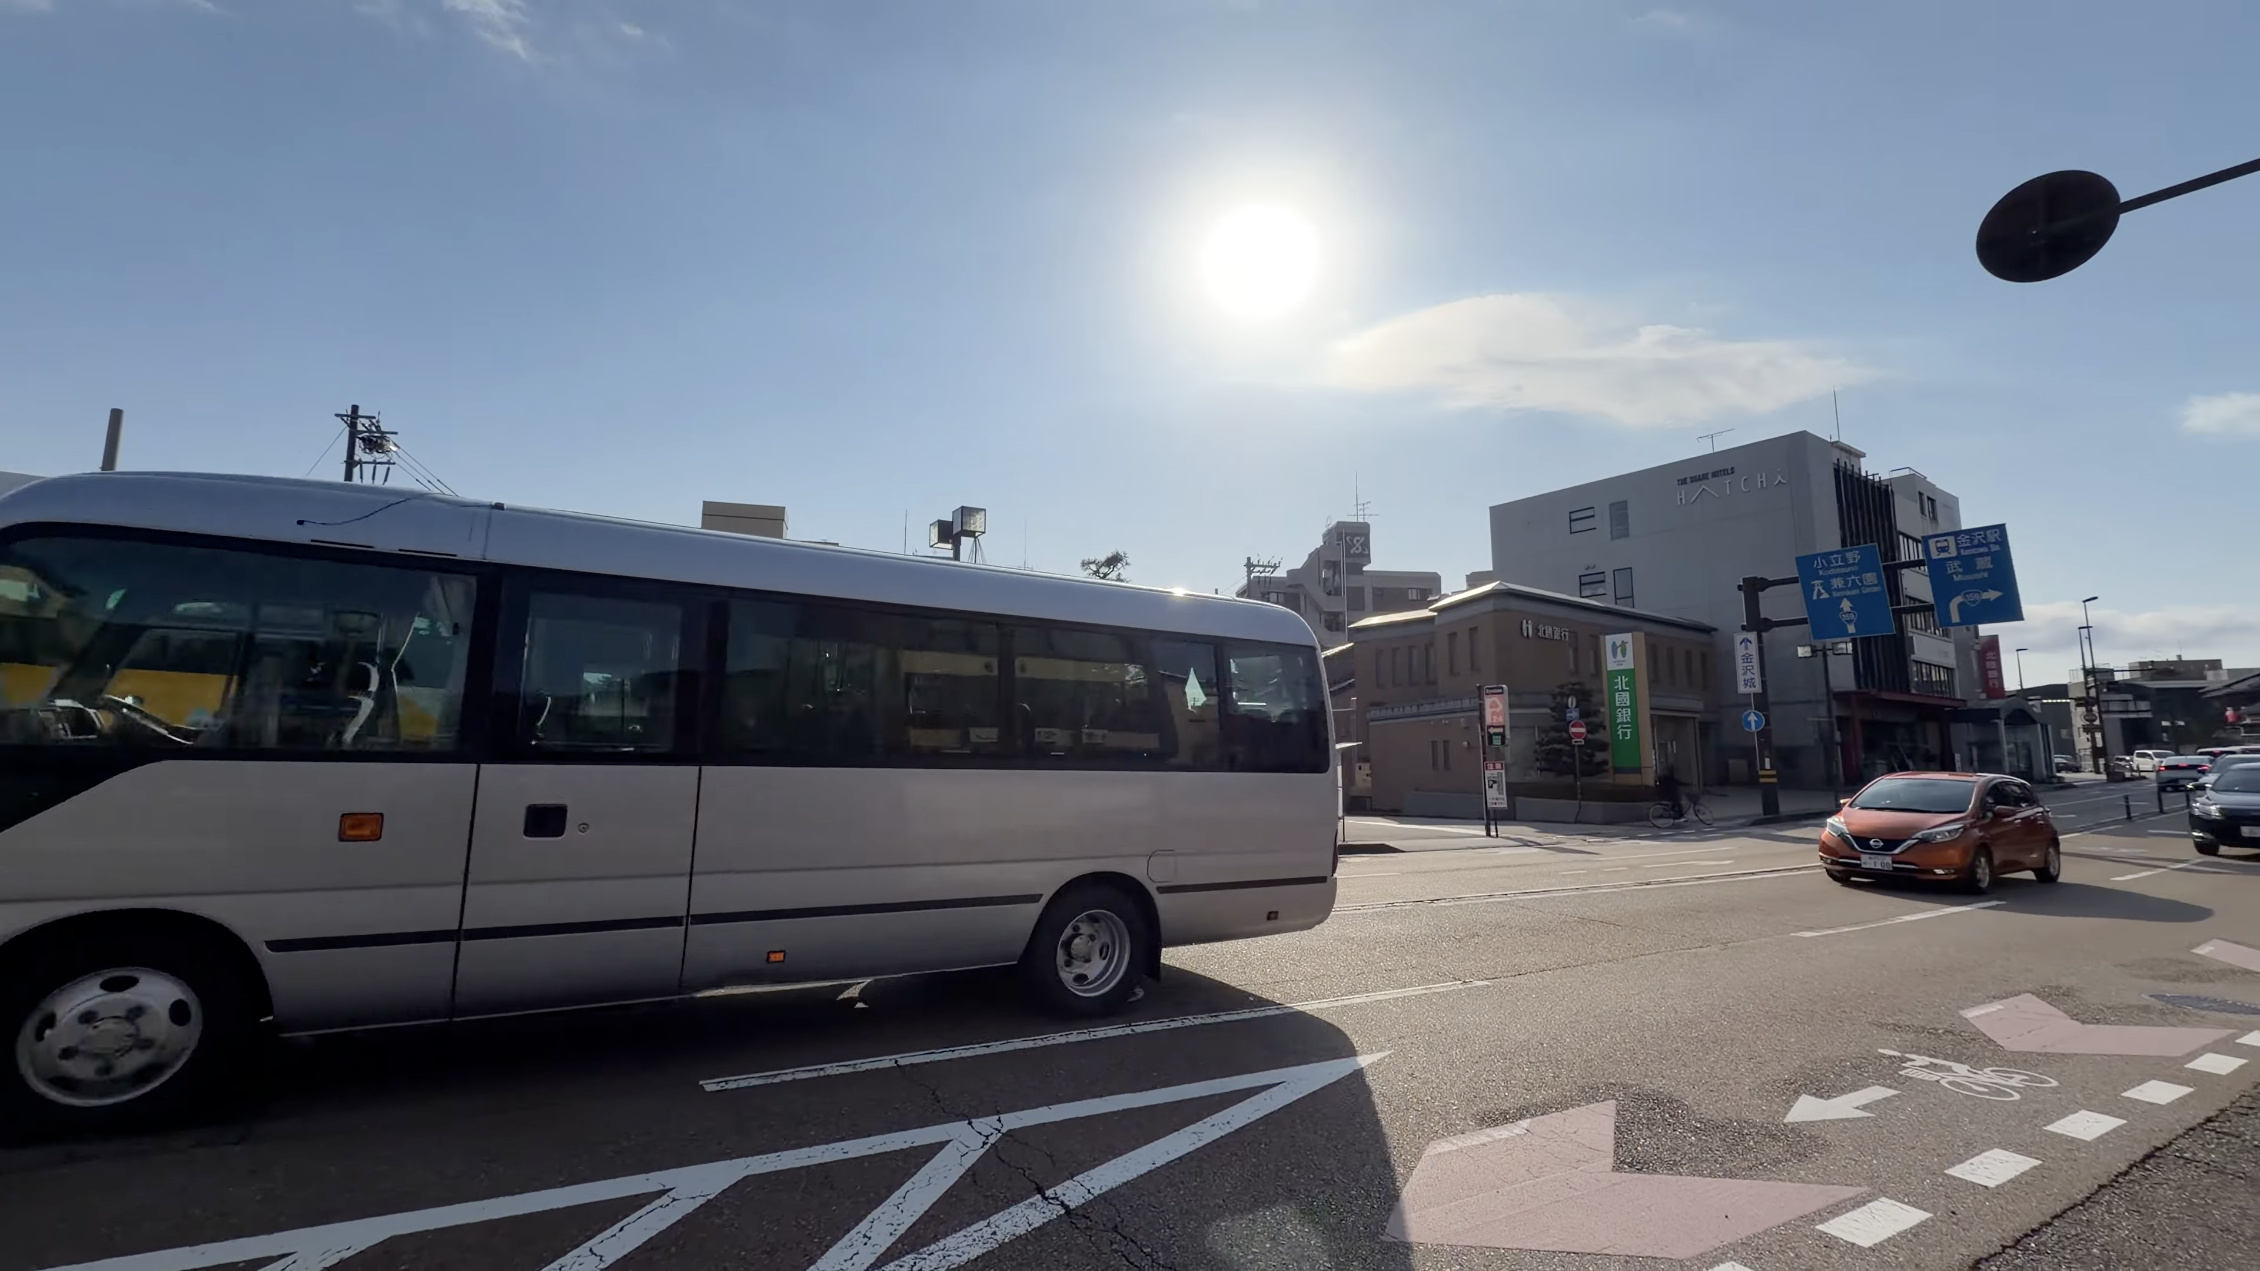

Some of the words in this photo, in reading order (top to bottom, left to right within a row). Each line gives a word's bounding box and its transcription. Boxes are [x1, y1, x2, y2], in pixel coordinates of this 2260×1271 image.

[1711, 466, 1736, 478] HOTELS
[1956, 529, 2002, 548] 金沢駅
[1813, 550, 1861, 569] 小立野
[1830, 572, 1878, 589] 兼六園
[1740, 651, 1757, 689] 金沢城
[1614, 675, 1632, 740] 北國銀行
